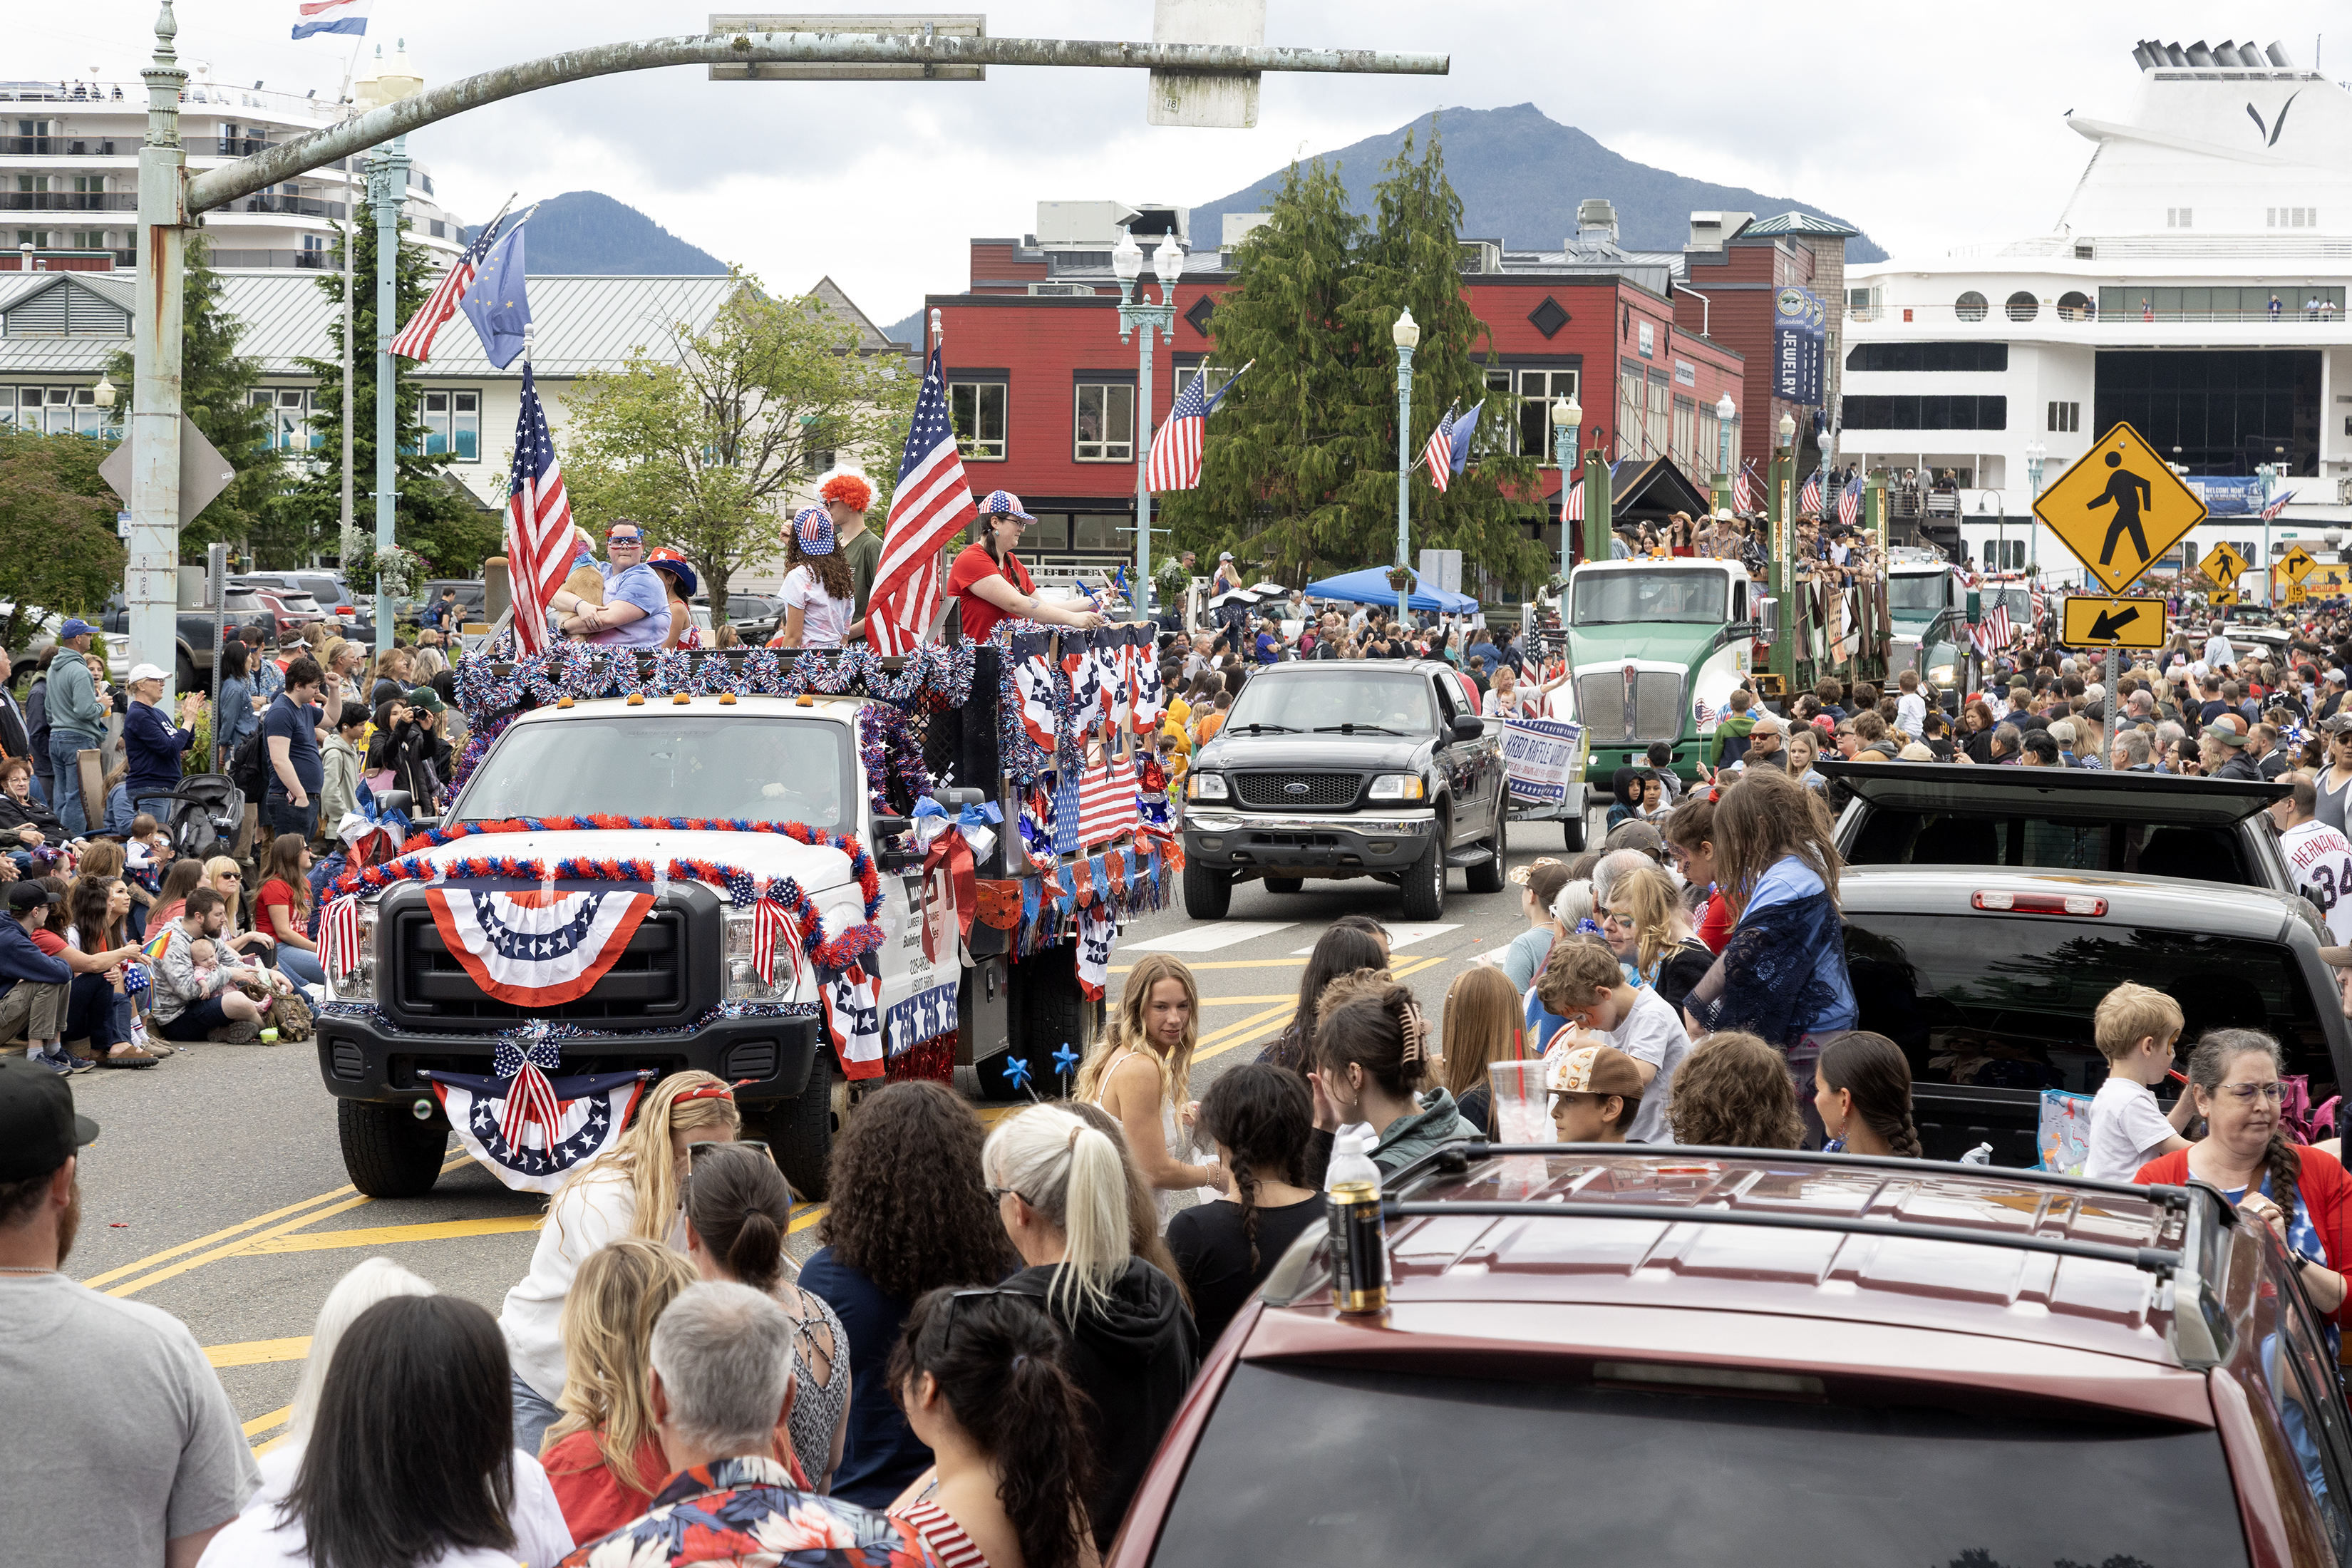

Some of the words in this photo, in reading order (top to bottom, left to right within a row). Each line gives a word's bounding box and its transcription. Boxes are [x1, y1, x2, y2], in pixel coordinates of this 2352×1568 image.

[1167, 99, 1177, 108] 18
[1783, 331, 1797, 395] JEWELRY
[2293, 587, 2303, 596] 15
[1505, 734, 1529, 759] KRBD
[909, 882, 934, 902] MADON
[2311, 857, 2352, 910] 34
[907, 917, 920, 929] LUMBER
[903, 933, 920, 948] Building
